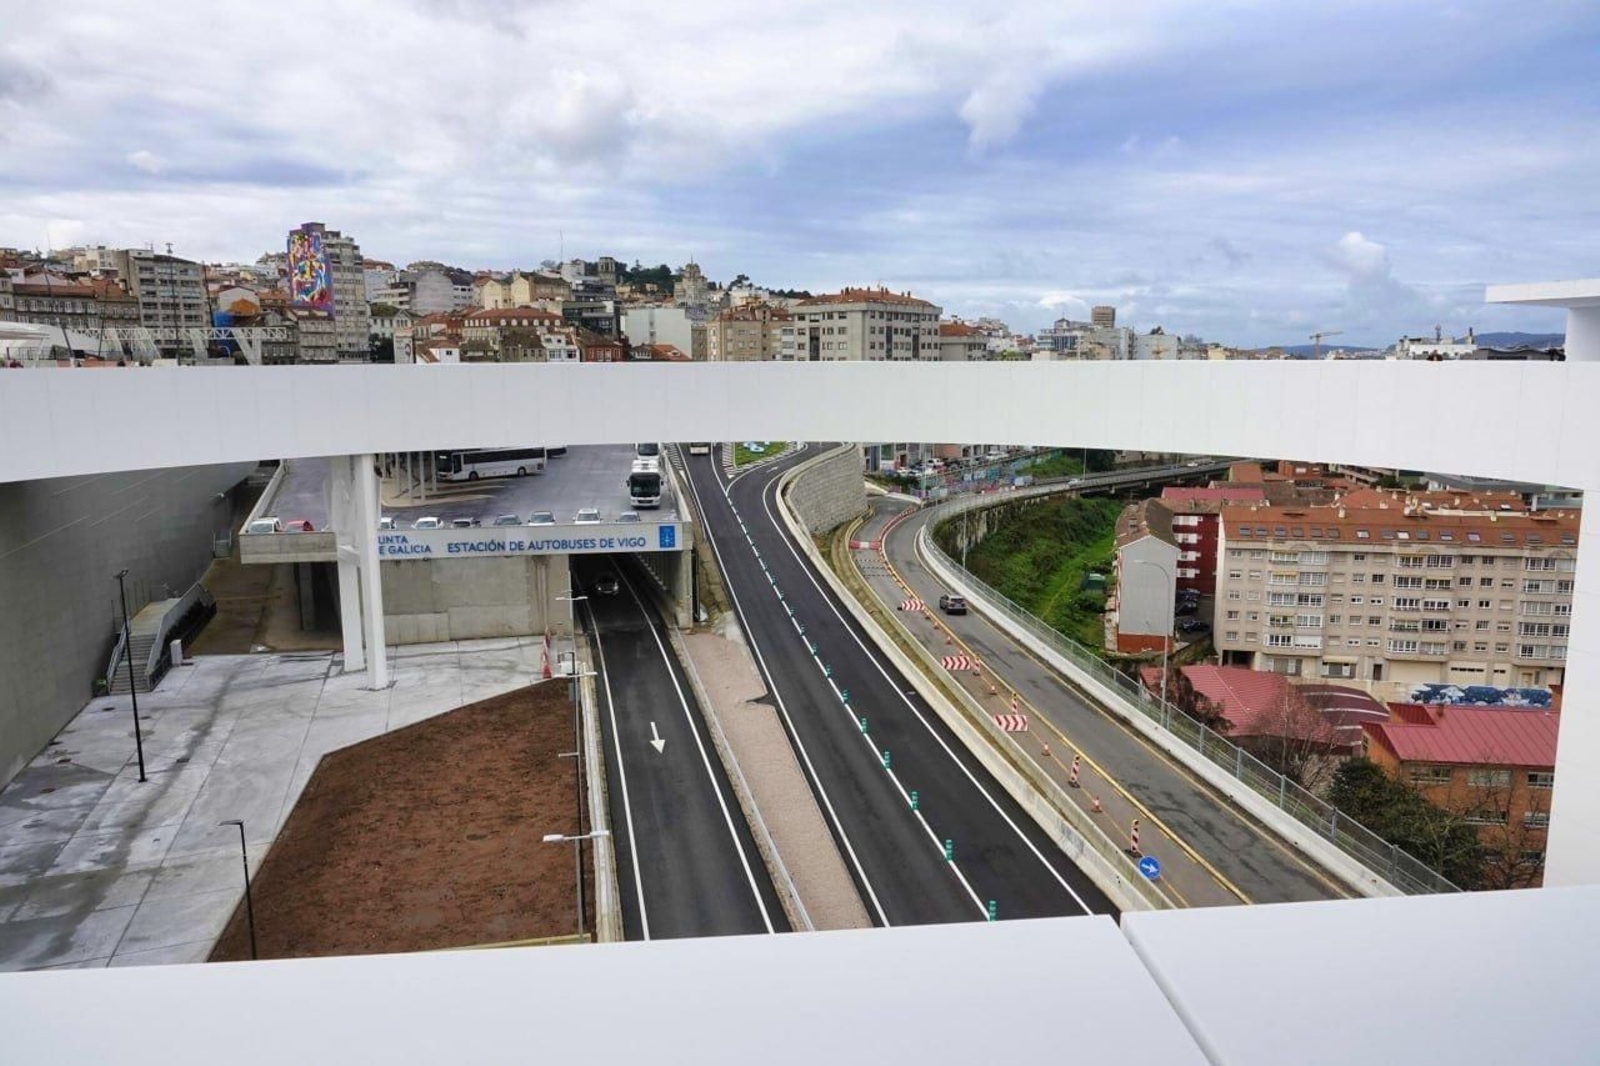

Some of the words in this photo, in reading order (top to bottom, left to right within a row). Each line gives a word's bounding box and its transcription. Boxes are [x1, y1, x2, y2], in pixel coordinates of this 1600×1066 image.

[378, 535, 408, 545] UNTA
[447, 540, 505, 553] ESTACIÓN
[509, 541, 524, 551] DE
[528, 539, 596, 551] AUTOBUSES
[600, 538, 615, 548] DE
[617, 537, 646, 548] VIGO
[378, 545, 385, 555] E
[388, 545, 432, 554] GALICIA
